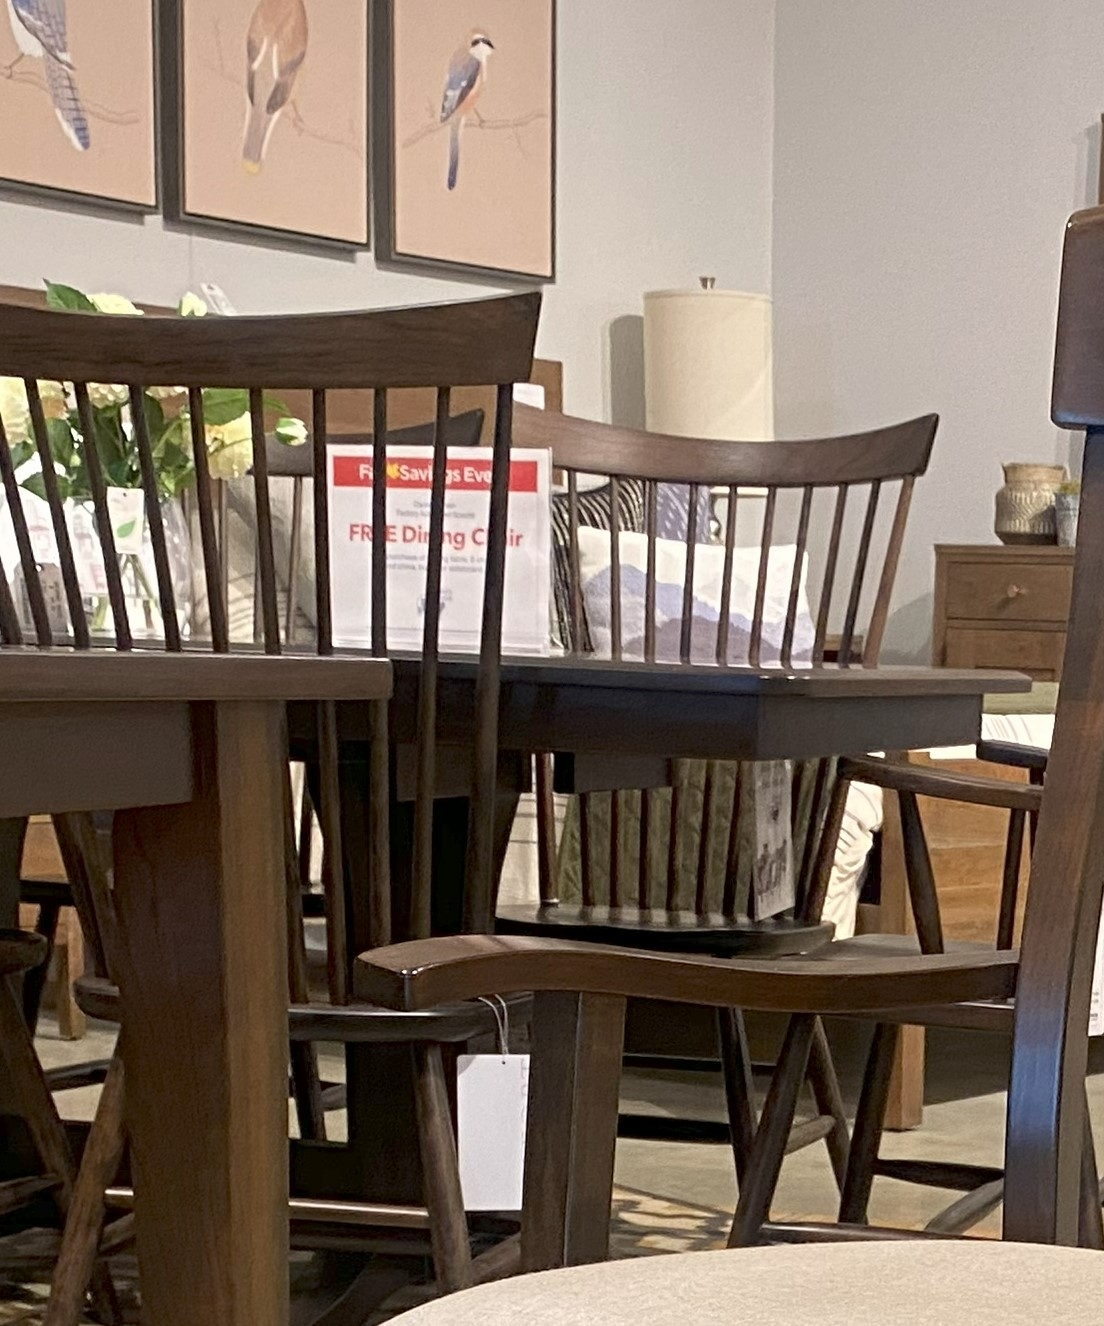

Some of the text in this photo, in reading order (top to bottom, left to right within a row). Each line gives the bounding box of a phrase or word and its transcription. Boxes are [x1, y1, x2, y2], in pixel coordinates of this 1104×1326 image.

[400, 463, 461, 484] Savigs
[464, 466, 499, 483] Eve
[349, 524, 523, 550] FRE Dinng Cir
